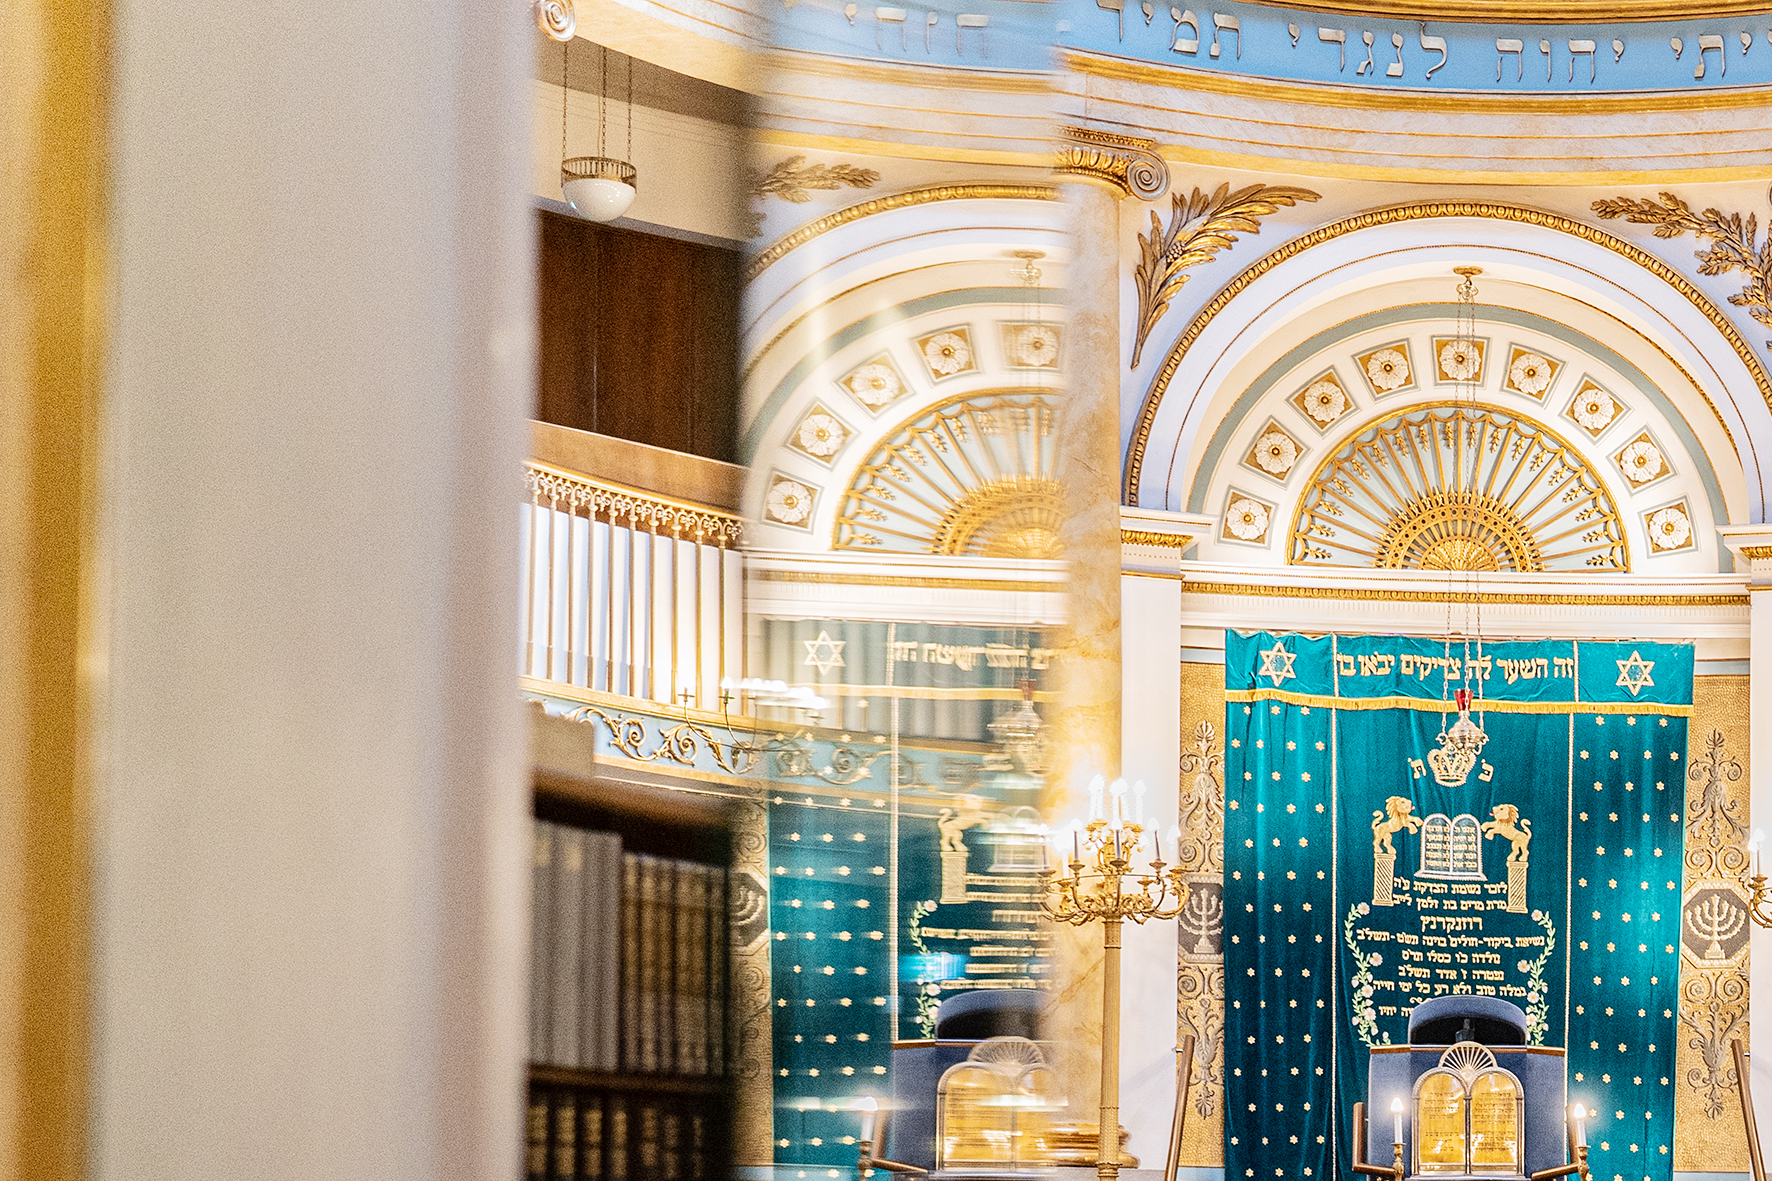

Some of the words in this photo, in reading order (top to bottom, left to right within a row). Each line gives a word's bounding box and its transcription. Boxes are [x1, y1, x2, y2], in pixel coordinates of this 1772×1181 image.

[1096, 0, 1241, 60] תמיד
[1288, 20, 1448, 79] לנגדי
[1496, 37, 1625, 84] יהוה
[1400, 653, 1462, 682] צדיקים
[1496, 657, 1549, 685] השער
[1553, 656, 1574, 679] זה
[1451, 883, 1481, 895] נשמת
[1484, 881, 1508, 895] לזכר
[1416, 897, 1439, 912] זלמן
[1443, 899, 1458, 910] בת
[1460, 900, 1485, 911] מרים
[1486, 899, 1507, 911] מרת
[1435, 968, 1458, 980] אדר
[1415, 981, 1431, 994] כל
[1434, 984, 1449, 996] רע
[1453, 982, 1472, 995] ולא
[1475, 984, 1496, 997] טוב
